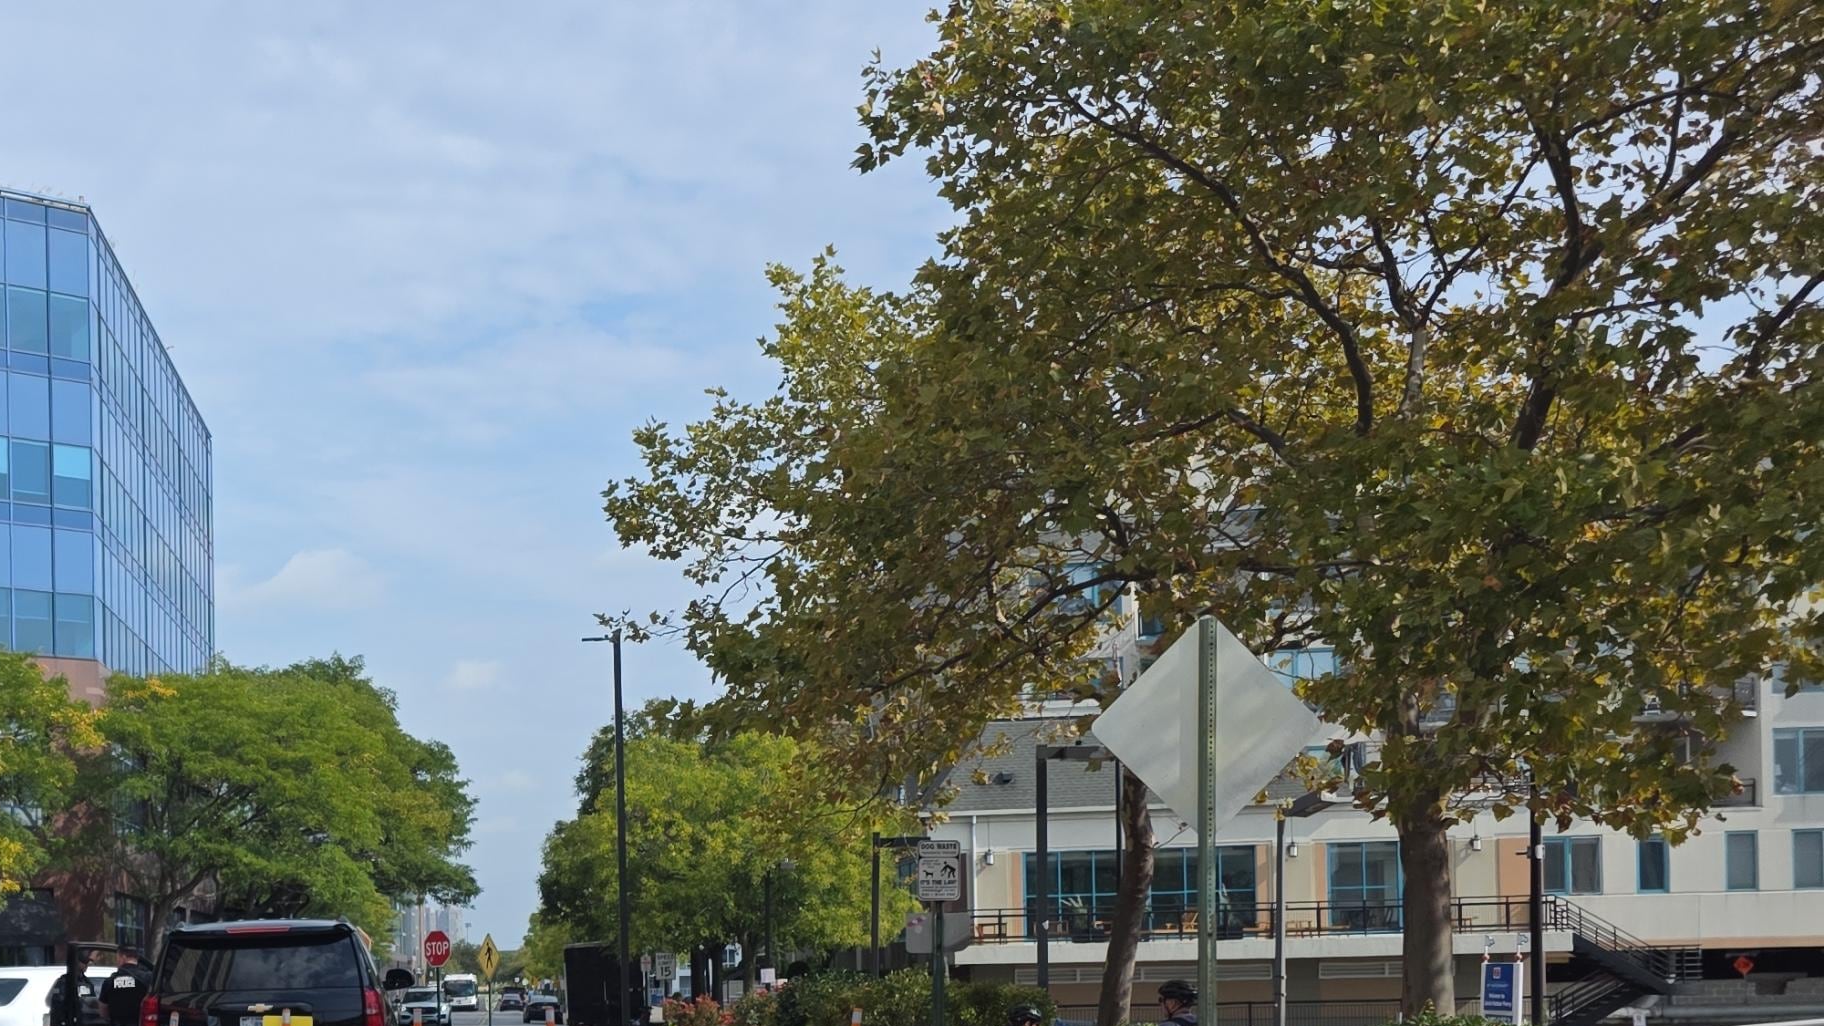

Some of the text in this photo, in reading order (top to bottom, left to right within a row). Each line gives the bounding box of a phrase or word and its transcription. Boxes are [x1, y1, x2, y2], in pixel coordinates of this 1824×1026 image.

[426, 941, 449, 956] STOP
[660, 966, 672, 977] 15
[113, 975, 136, 989] POLICE
